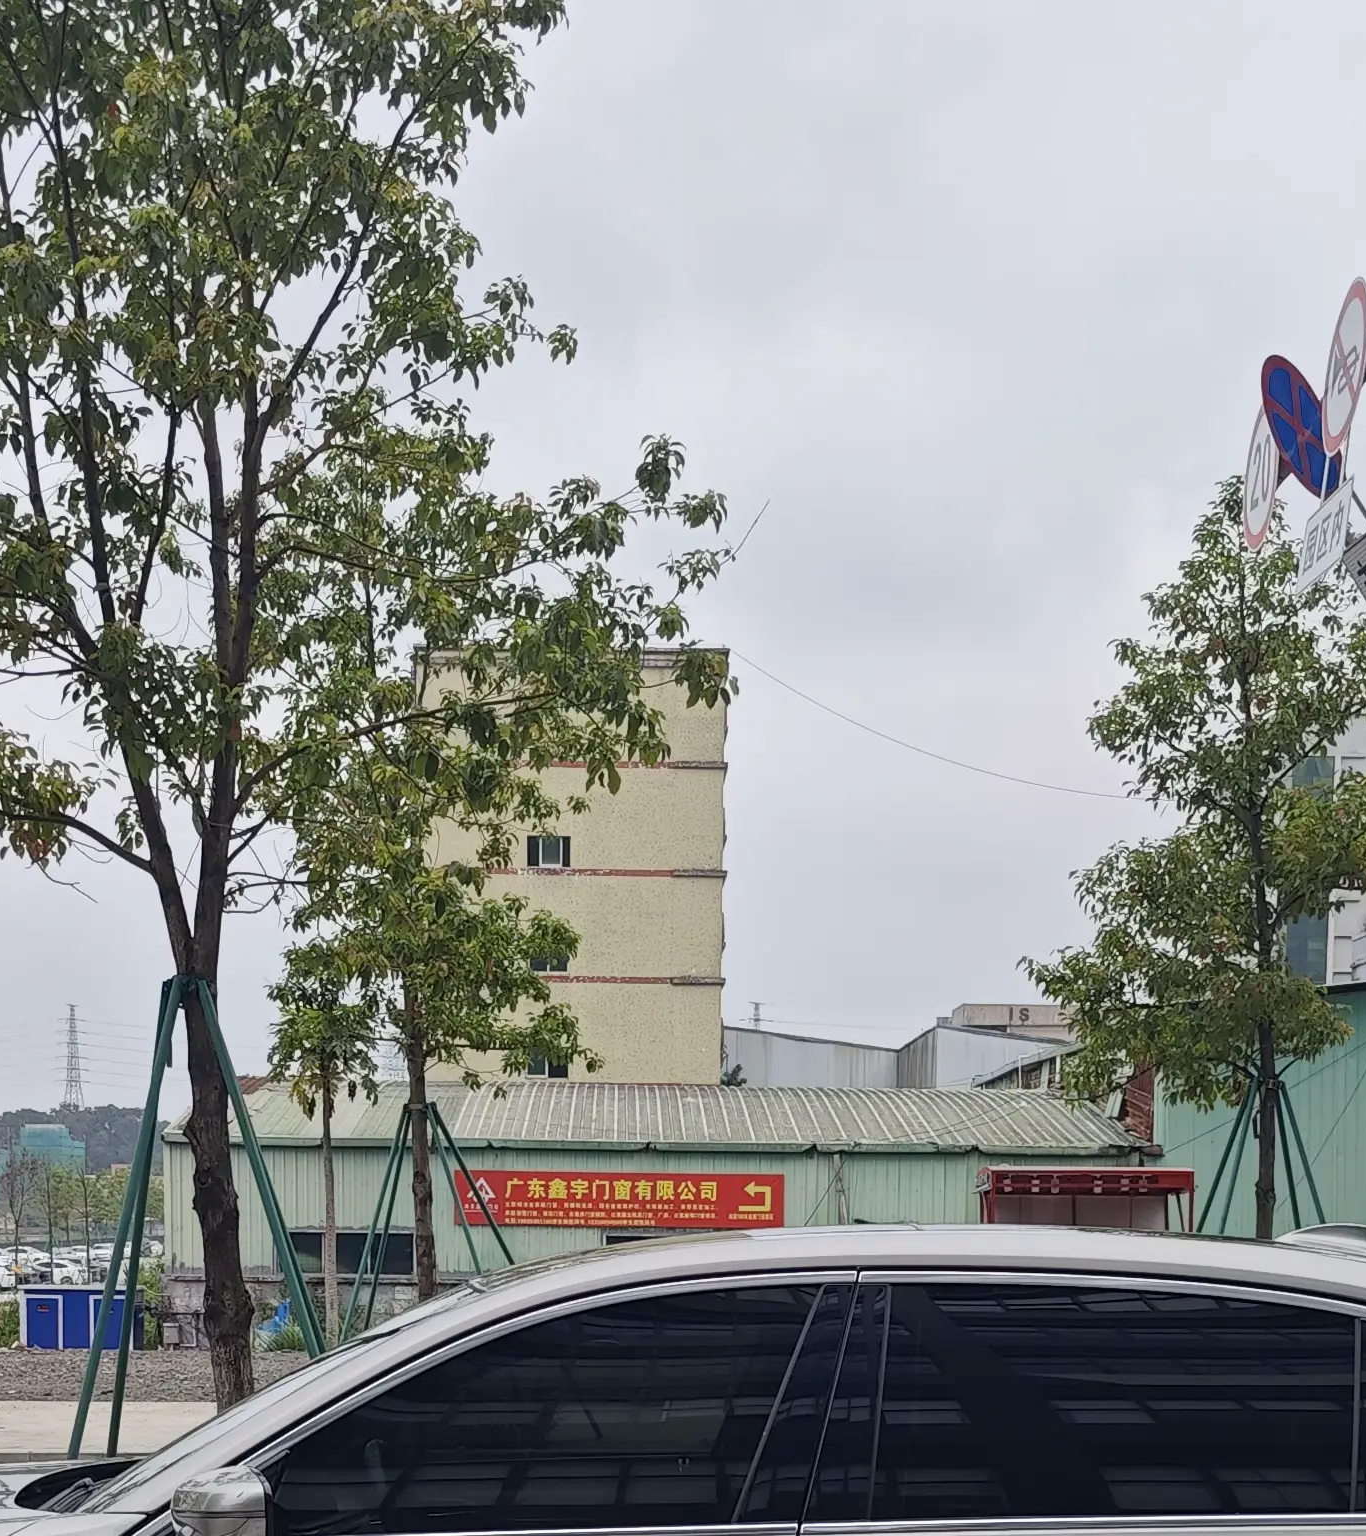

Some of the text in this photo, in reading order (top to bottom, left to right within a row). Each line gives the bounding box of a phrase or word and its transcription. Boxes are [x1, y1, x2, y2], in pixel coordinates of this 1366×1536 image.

[1249, 433, 1271, 513] 20
[1302, 499, 1345, 576] 园区内
[504, 1177, 718, 1201] 广东鑫宇门窗有限公司
